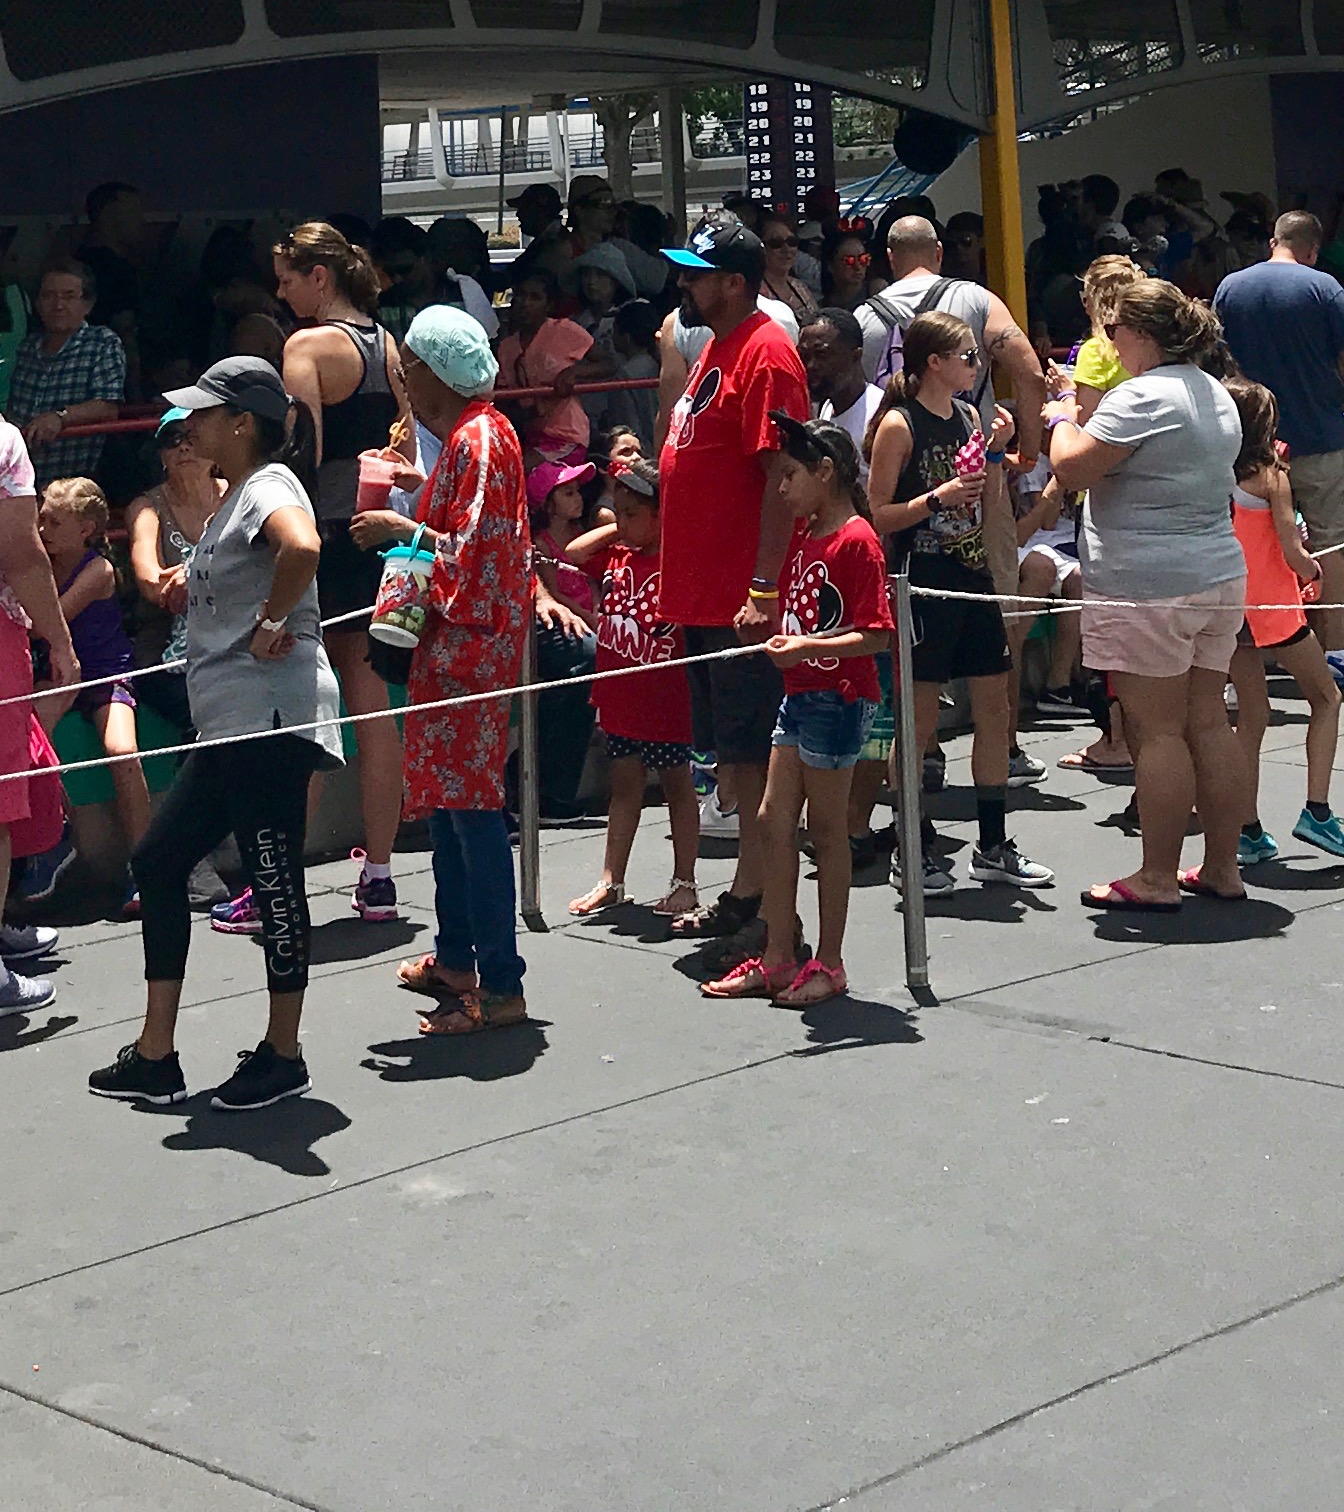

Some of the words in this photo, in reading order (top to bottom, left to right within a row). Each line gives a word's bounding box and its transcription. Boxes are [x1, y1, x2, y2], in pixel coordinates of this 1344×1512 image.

[749, 83, 768, 95] 18
[749, 101, 768, 113] 19
[795, 98, 812, 109] 19
[747, 118, 769, 130] 20
[793, 116, 813, 127] 20
[748, 135, 770, 147] 21
[794, 133, 814, 144] 21
[749, 153, 771, 164] 22
[795, 150, 815, 161] 22
[750, 169, 772, 181] 23
[796, 167, 815, 178] 23
[751, 187, 772, 199] 24
[249, 828, 281, 891] Klein
[277, 832, 305, 973] PERFORMANCE
[268, 896, 294, 976] Calvin
